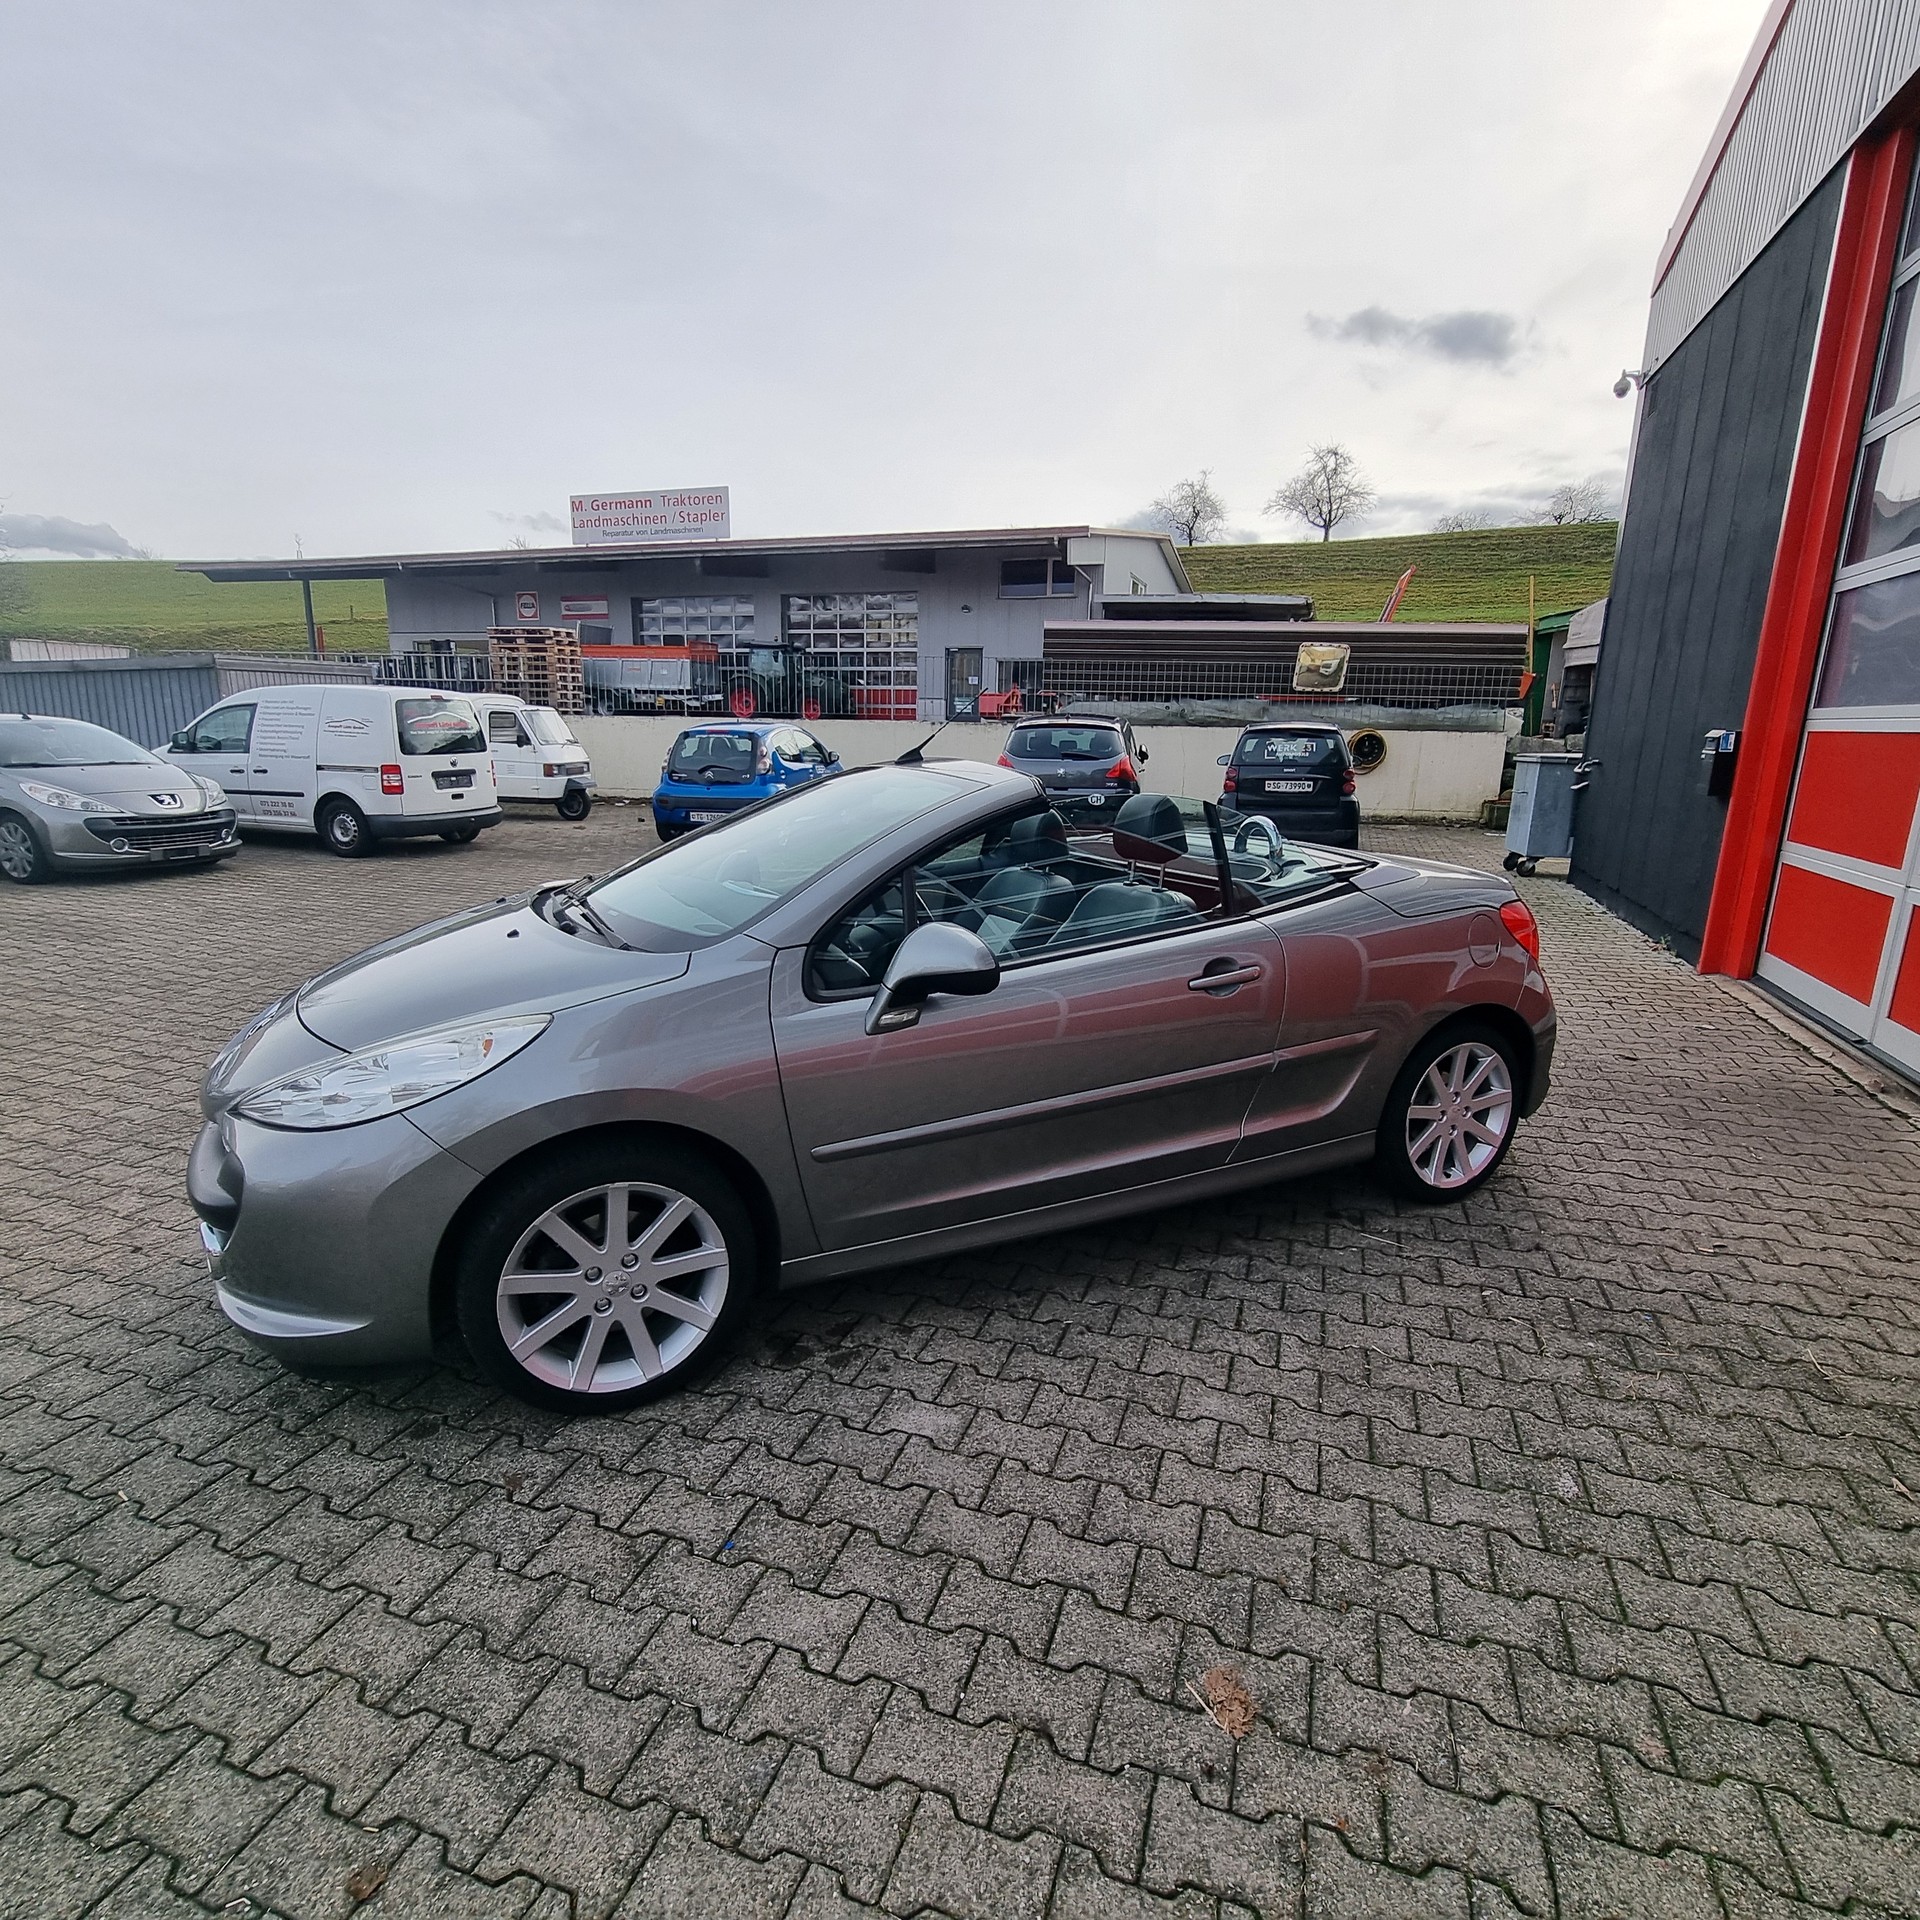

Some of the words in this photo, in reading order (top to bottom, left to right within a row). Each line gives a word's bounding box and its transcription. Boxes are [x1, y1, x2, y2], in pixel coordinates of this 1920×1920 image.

[571, 500, 587, 512] M.
[591, 499, 652, 511] Germann
[660, 493, 723, 507] Traktoren
[572, 512, 667, 529] Landmaschinen
[602, 529, 634, 538] Reparatur
[650, 526, 704, 536] Landmaschinen
[1267, 744, 1297, 752] WERK
[1285, 782, 1306, 790] 73990
